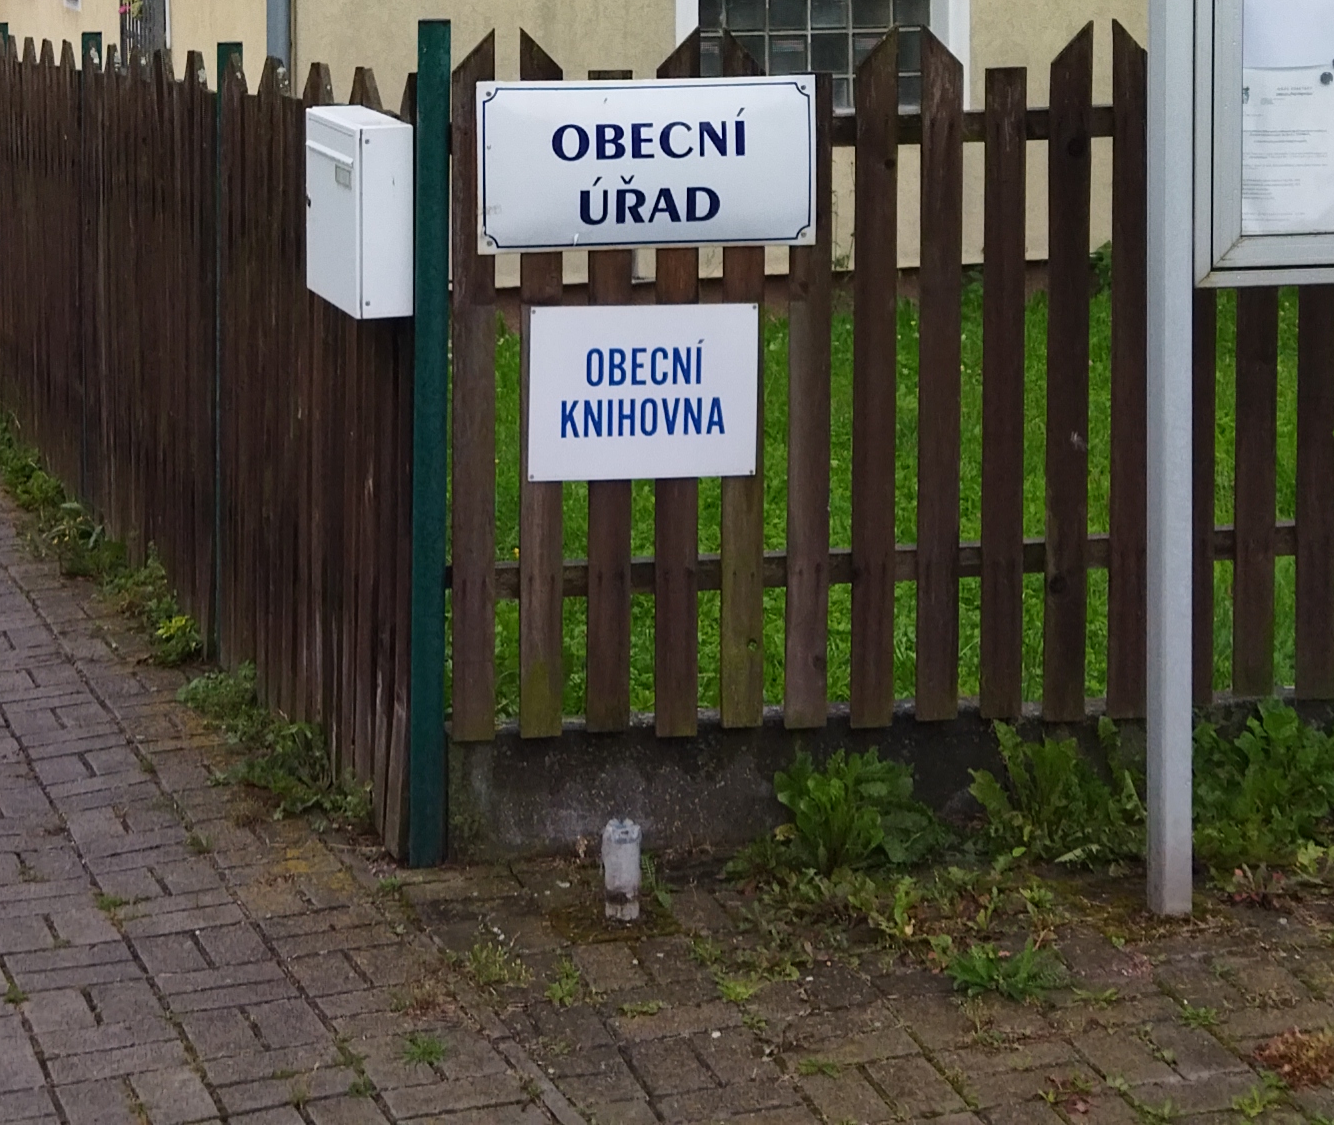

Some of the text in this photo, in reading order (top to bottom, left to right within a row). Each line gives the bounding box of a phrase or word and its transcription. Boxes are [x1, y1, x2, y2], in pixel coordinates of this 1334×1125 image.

[551, 108, 746, 162] OBECNÍ
[579, 176, 721, 225] ÚŘAD
[586, 339, 705, 388] OBECNÍ
[560, 397, 726, 439] KNIHOVNA
